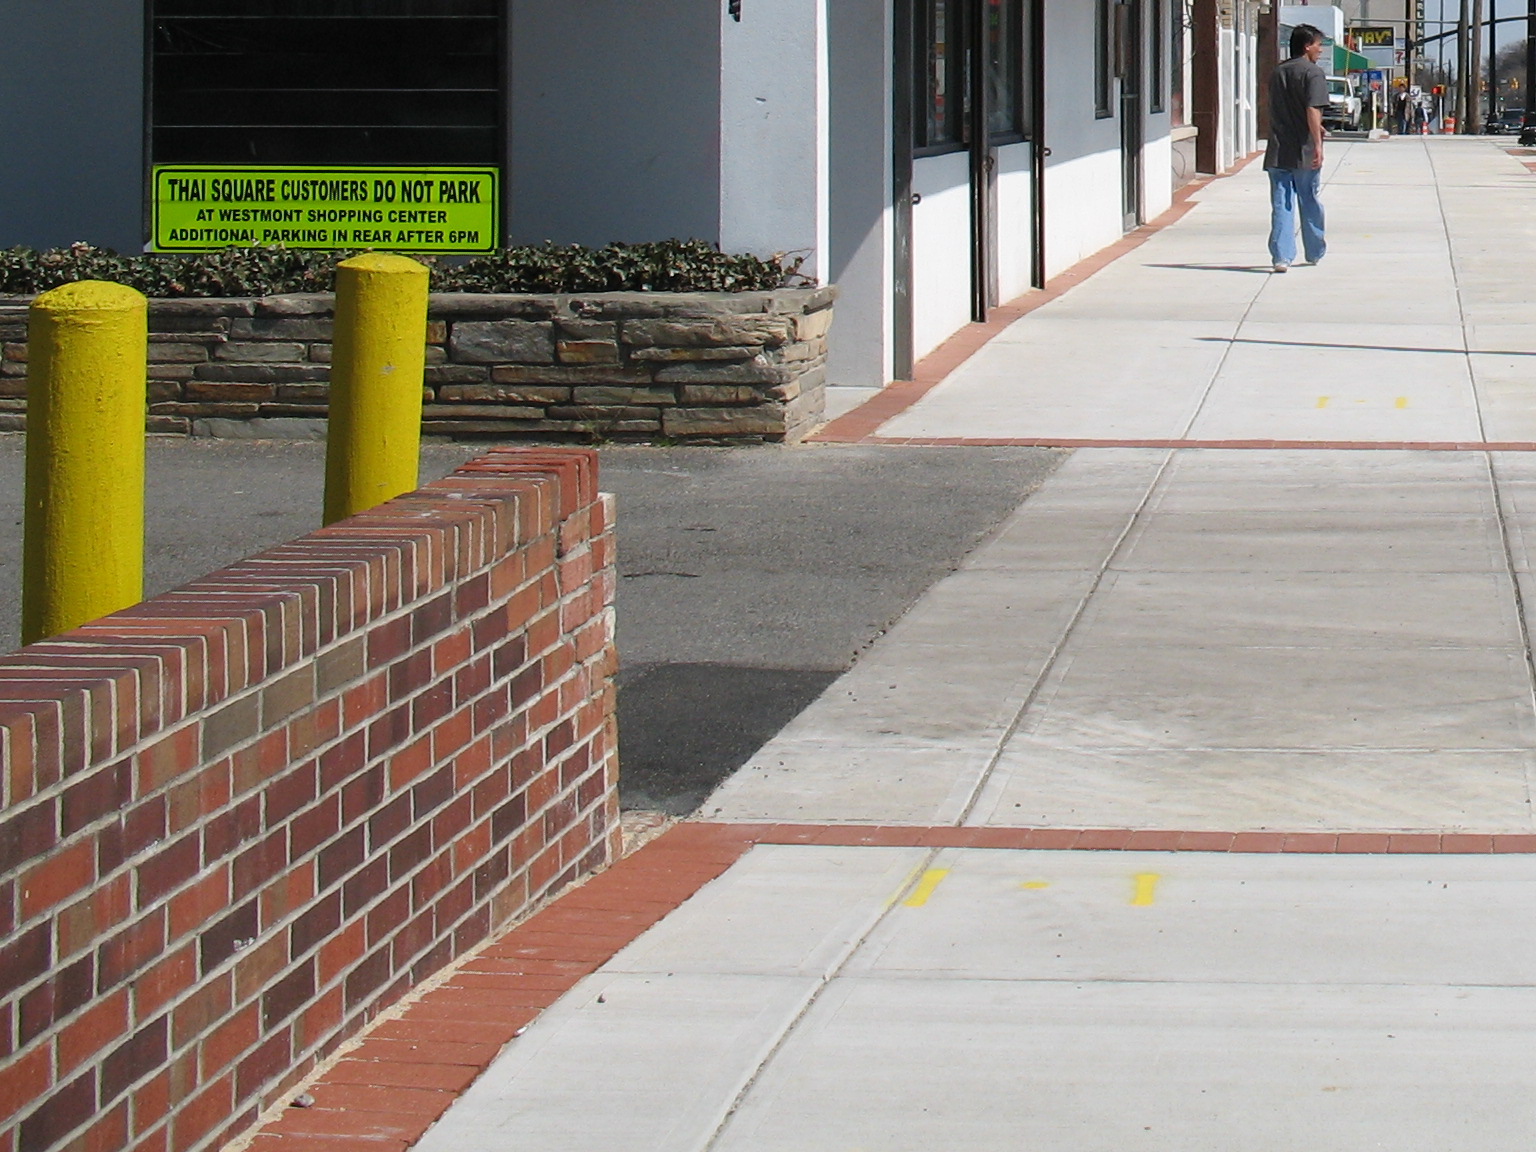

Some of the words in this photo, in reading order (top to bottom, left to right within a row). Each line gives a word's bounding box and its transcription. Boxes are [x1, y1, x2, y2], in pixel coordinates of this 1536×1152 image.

[168, 179, 205, 203] THAI
[211, 179, 276, 204] SQUARE
[281, 179, 369, 202] CUSTOMERS
[373, 180, 397, 203] DO
[401, 180, 435, 204] NOT
[439, 180, 481, 204] PARK
[196, 209, 216, 222] AT
[219, 209, 304, 223] WESTMONT
[307, 209, 384, 223] SHOPPING
[388, 210, 448, 224] CENTER
[169, 228, 258, 243] ADDITIONAL
[263, 229, 329, 243] PARKING
[332, 229, 349, 243] IN
[352, 229, 394, 243] REAR
[396, 230, 446, 244] AFTER
[449, 230, 480, 244] 6PM
